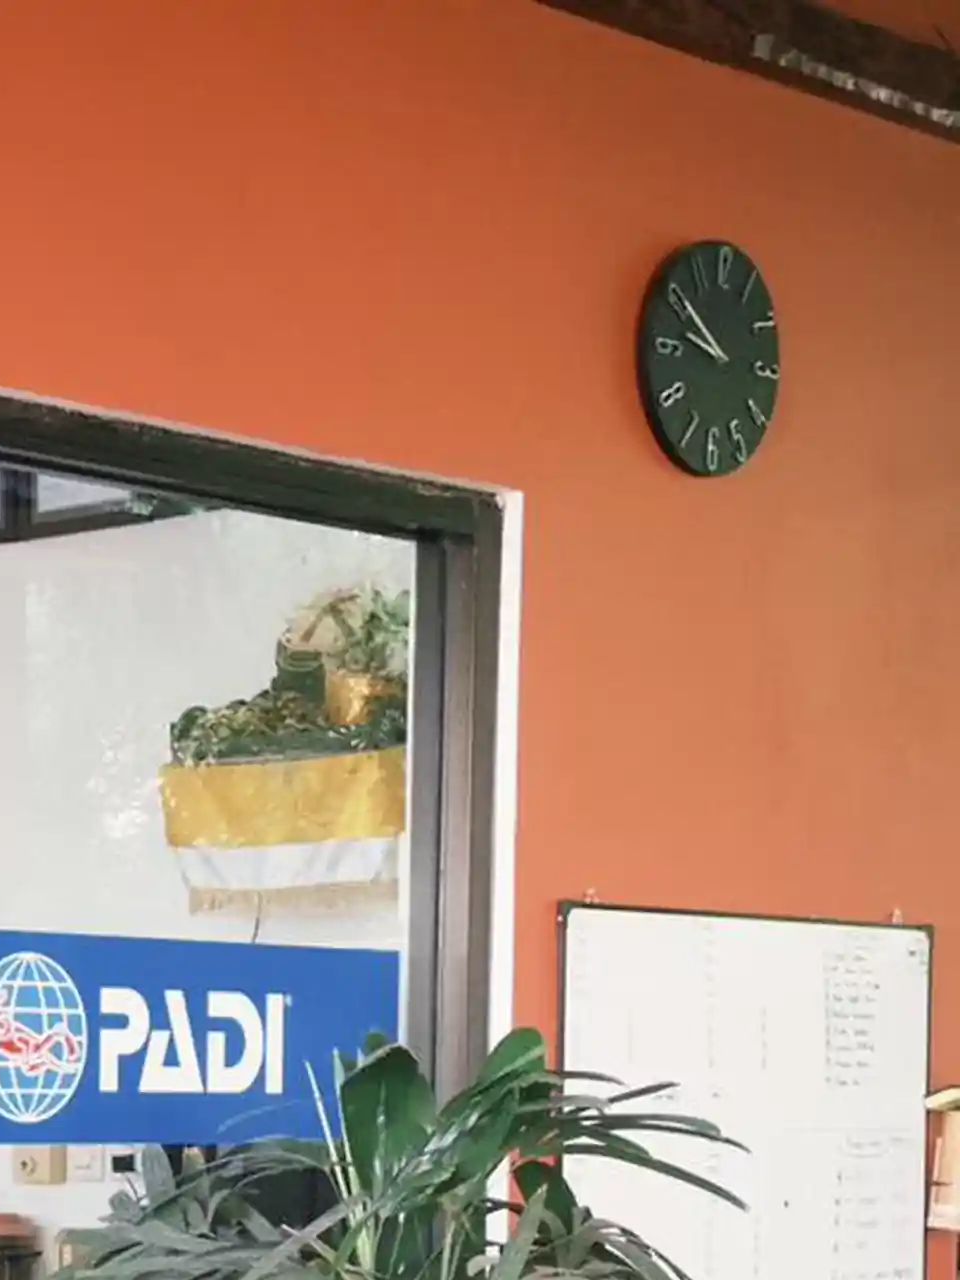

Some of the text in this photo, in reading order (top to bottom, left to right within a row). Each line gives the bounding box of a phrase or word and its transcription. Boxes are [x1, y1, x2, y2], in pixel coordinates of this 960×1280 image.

[742, 269, 758, 305] 1
[654, 335, 684, 358] 9
[754, 360, 781, 380] 3
[659, 381, 685, 408] 8
[680, 410, 700, 449] 7
[748, 398, 768, 428] 4
[706, 426, 721, 471] 6
[729, 418, 747, 463] 5
[98, 987, 285, 1094] PADI
